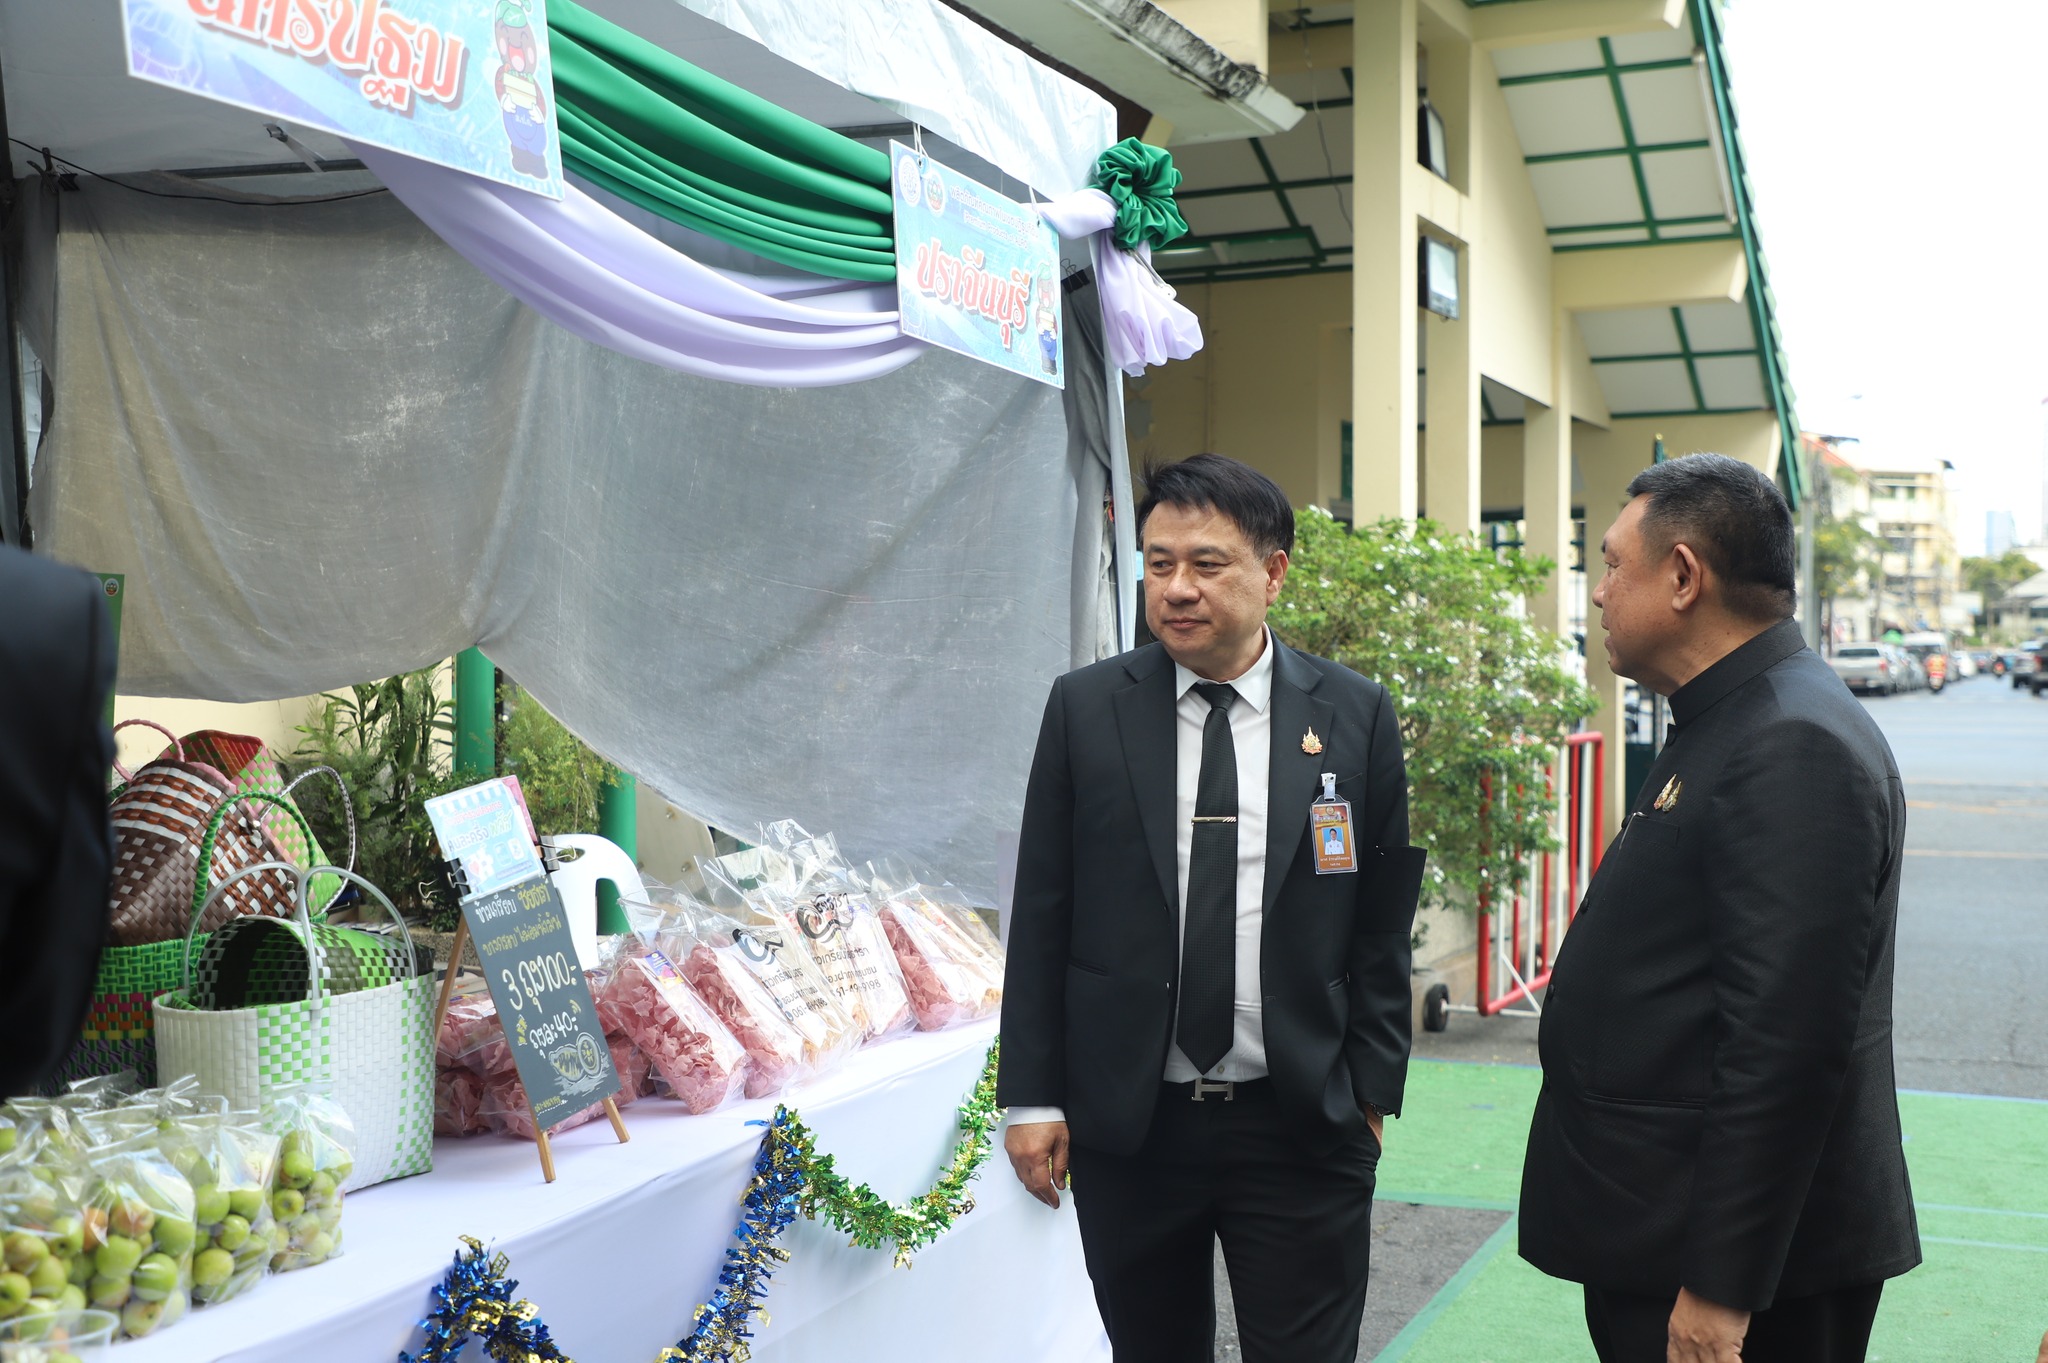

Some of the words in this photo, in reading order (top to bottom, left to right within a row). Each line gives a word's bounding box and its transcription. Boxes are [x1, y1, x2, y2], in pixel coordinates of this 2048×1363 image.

[187, 0, 463, 109] ครปฐม
[917, 239, 1031, 347] ปราจีนบุรี
